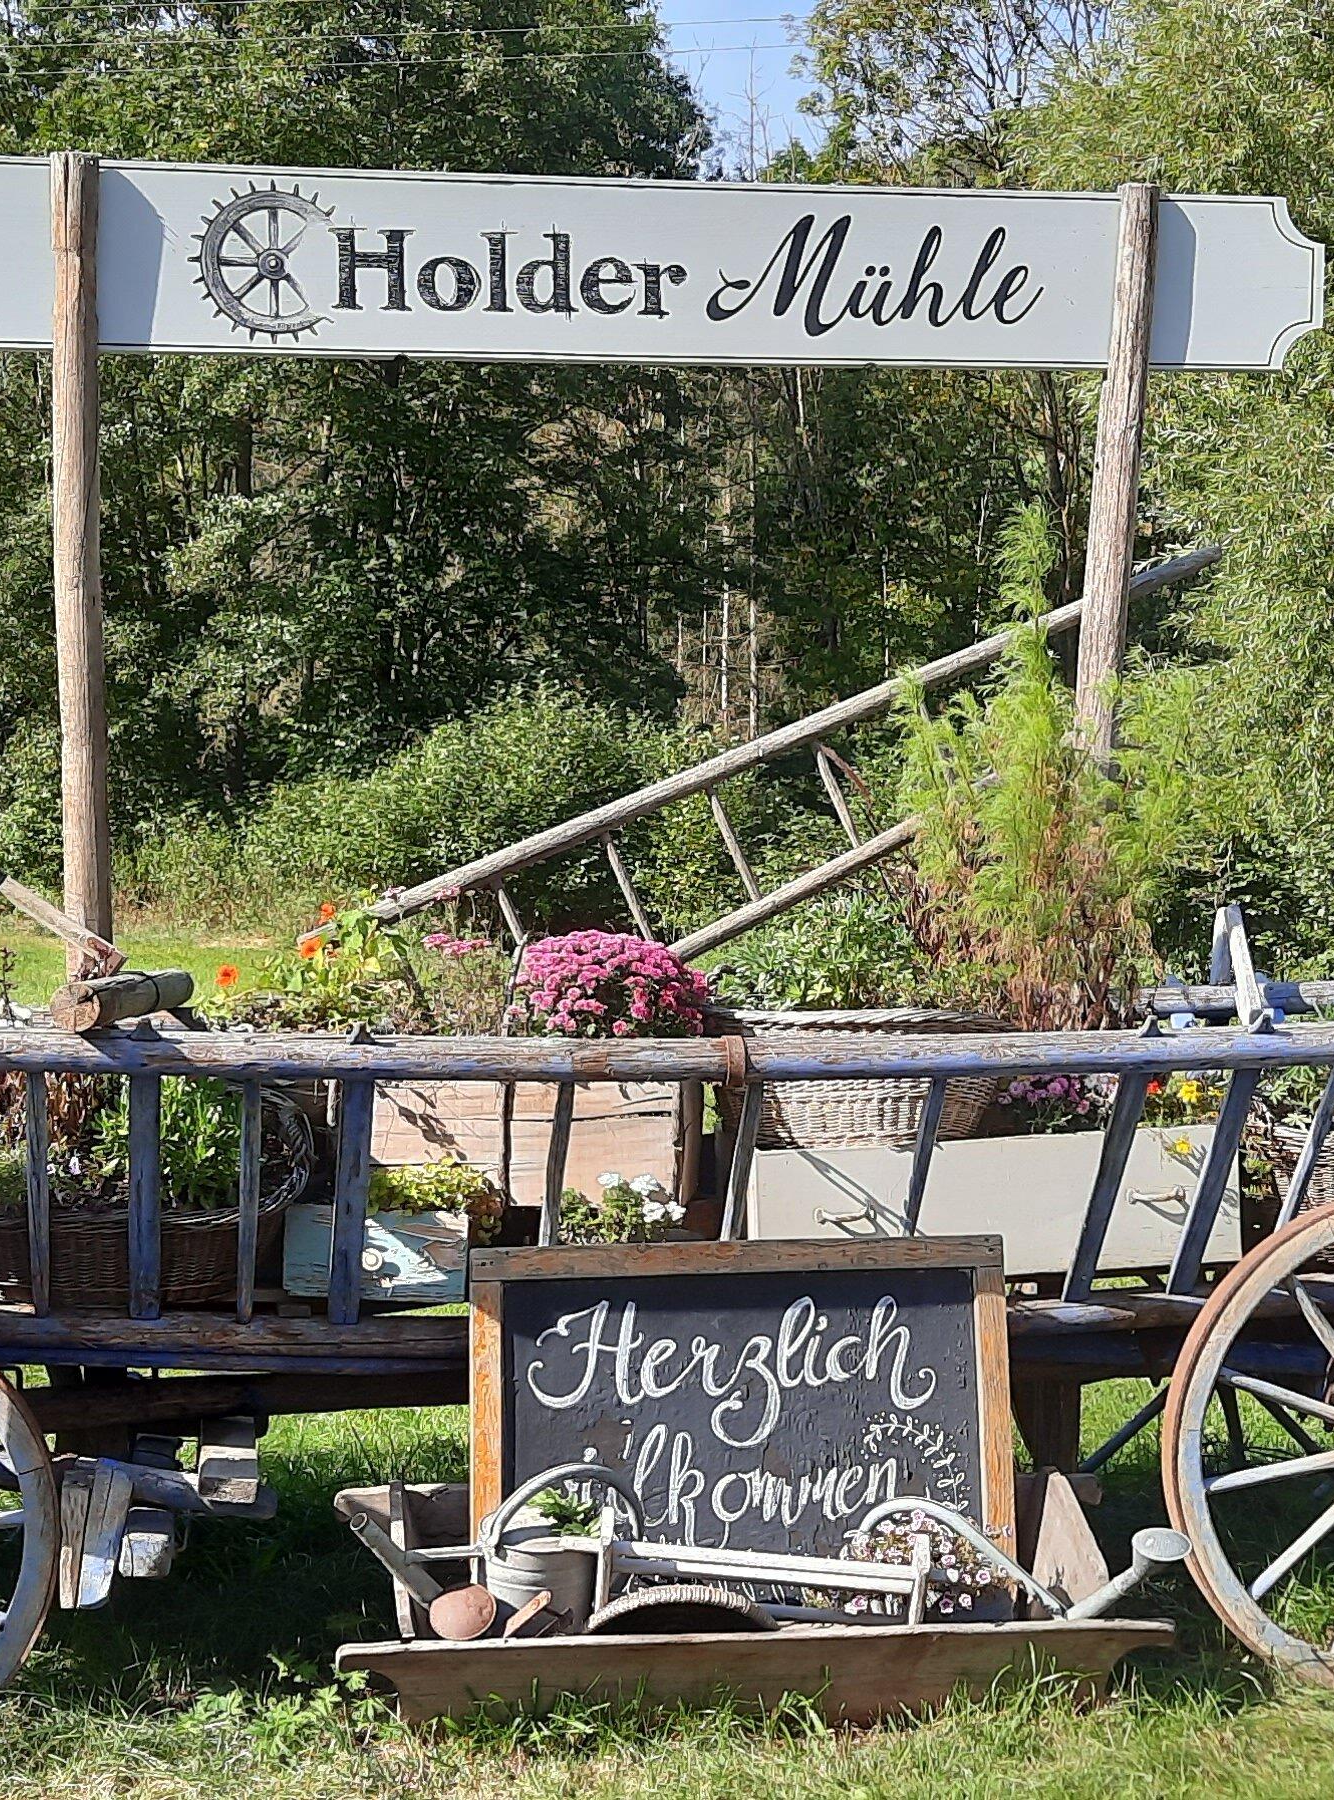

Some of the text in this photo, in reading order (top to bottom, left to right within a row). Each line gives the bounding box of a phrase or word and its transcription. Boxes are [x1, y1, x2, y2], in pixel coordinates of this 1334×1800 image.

[330, 213, 1045, 338] Holder Mühle
[527, 1295, 936, 1448] Herzlich
[562, 1420, 898, 1549] ilkommen
